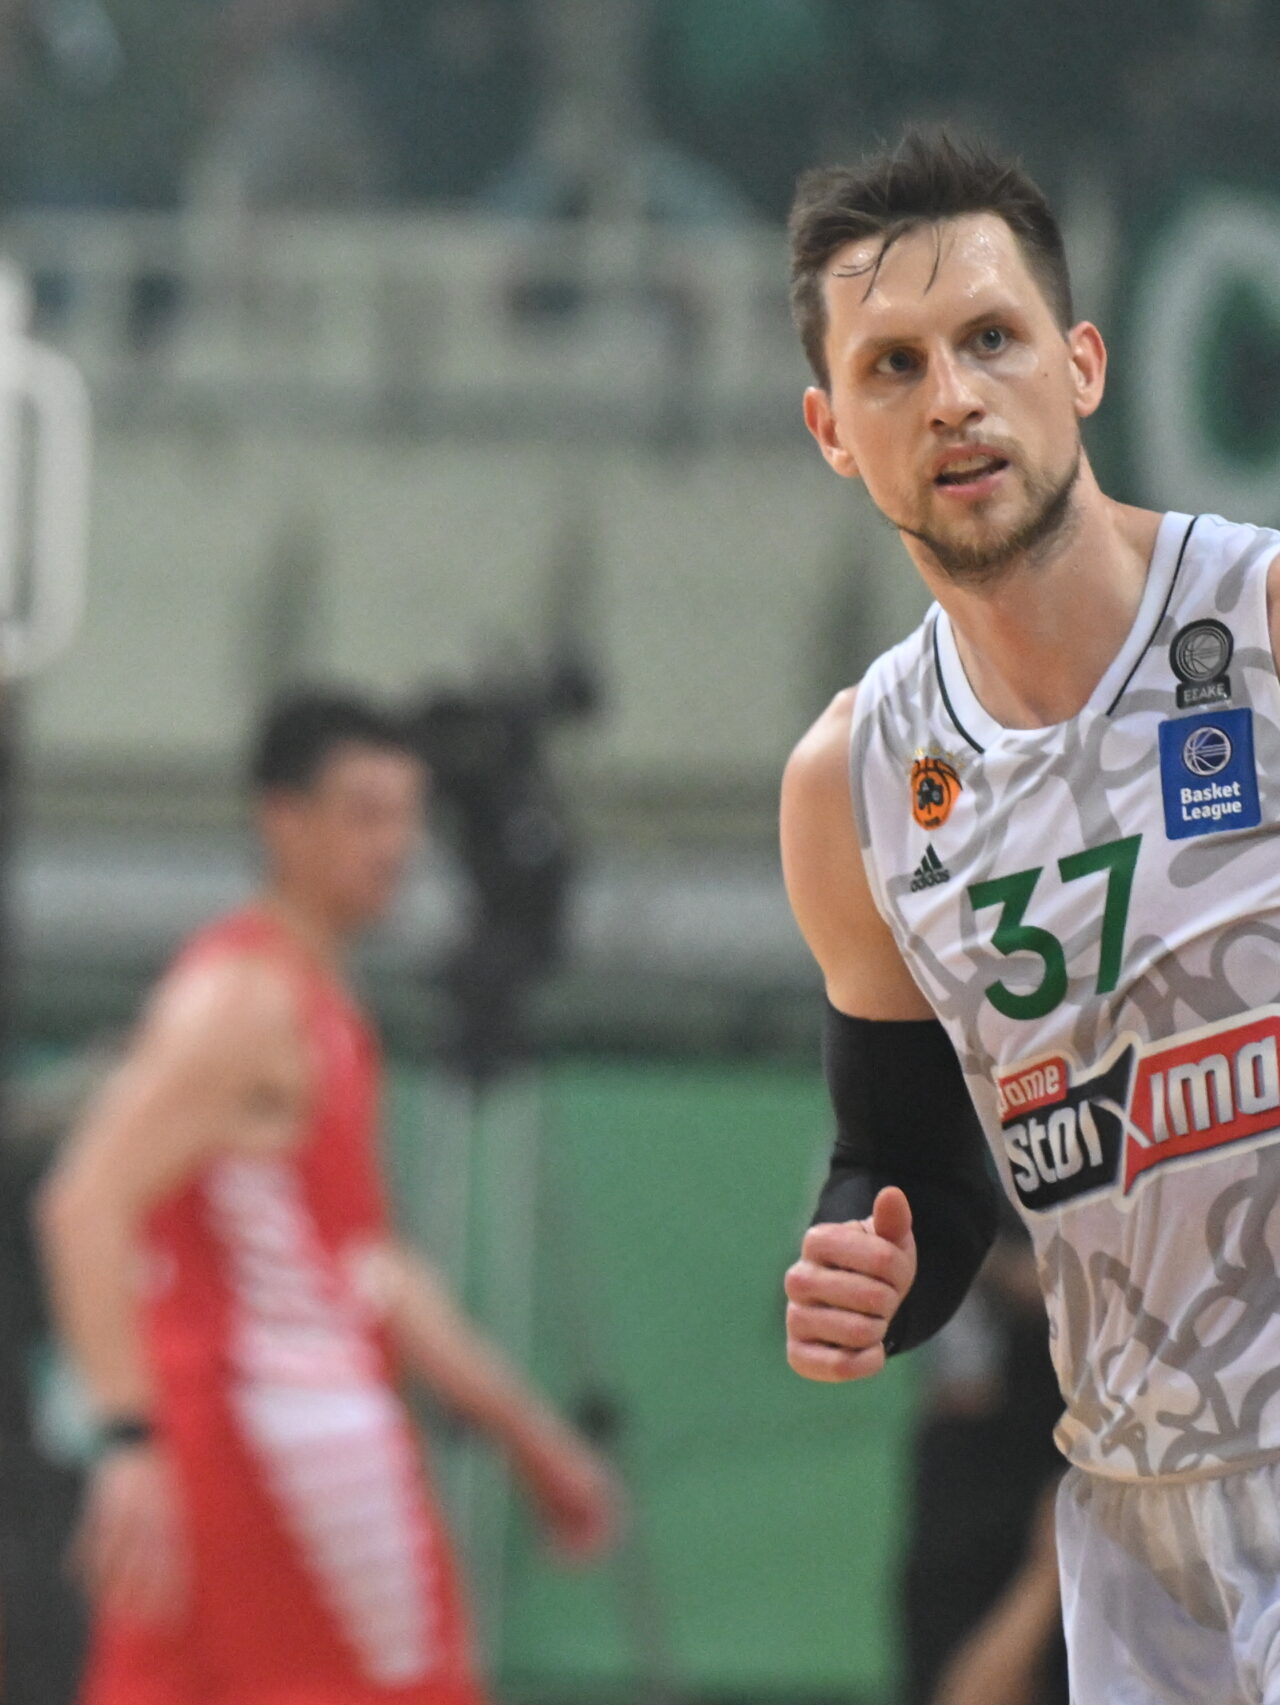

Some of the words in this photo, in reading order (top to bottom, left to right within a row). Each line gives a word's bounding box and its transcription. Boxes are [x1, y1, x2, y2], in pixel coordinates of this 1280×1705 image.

[1180, 780, 1241, 805] Basket
[1181, 800, 1242, 822] League
[967, 833, 1143, 1021] 37
